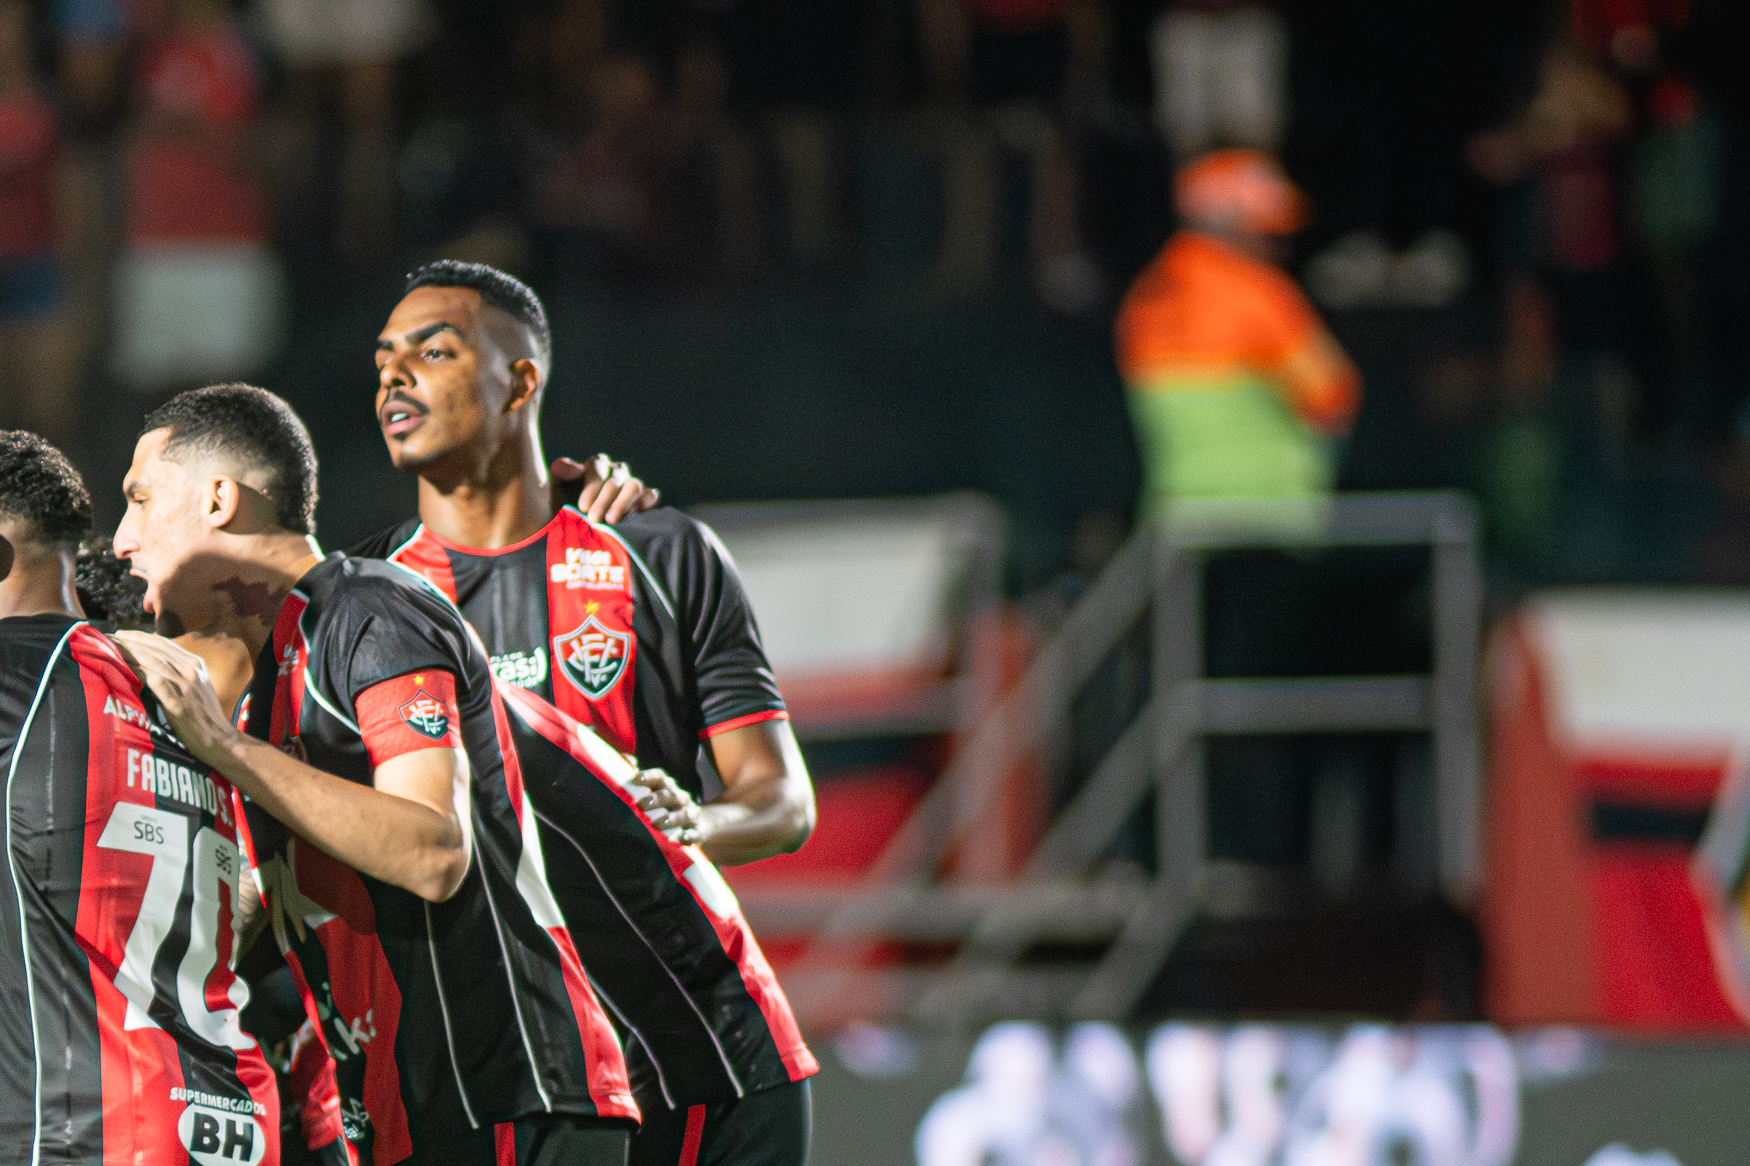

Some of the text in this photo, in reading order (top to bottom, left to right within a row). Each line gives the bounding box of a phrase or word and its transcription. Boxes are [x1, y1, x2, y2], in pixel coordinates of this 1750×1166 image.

[566, 548, 610, 565] VIVA
[551, 563, 624, 582] SORTE
[127, 748, 218, 816] FABIANO
[134, 820, 164, 845] SBS
[96, 801, 256, 1050] 70
[170, 1087, 266, 1116] SUPERMERCADOS
[189, 1111, 254, 1162] BH
